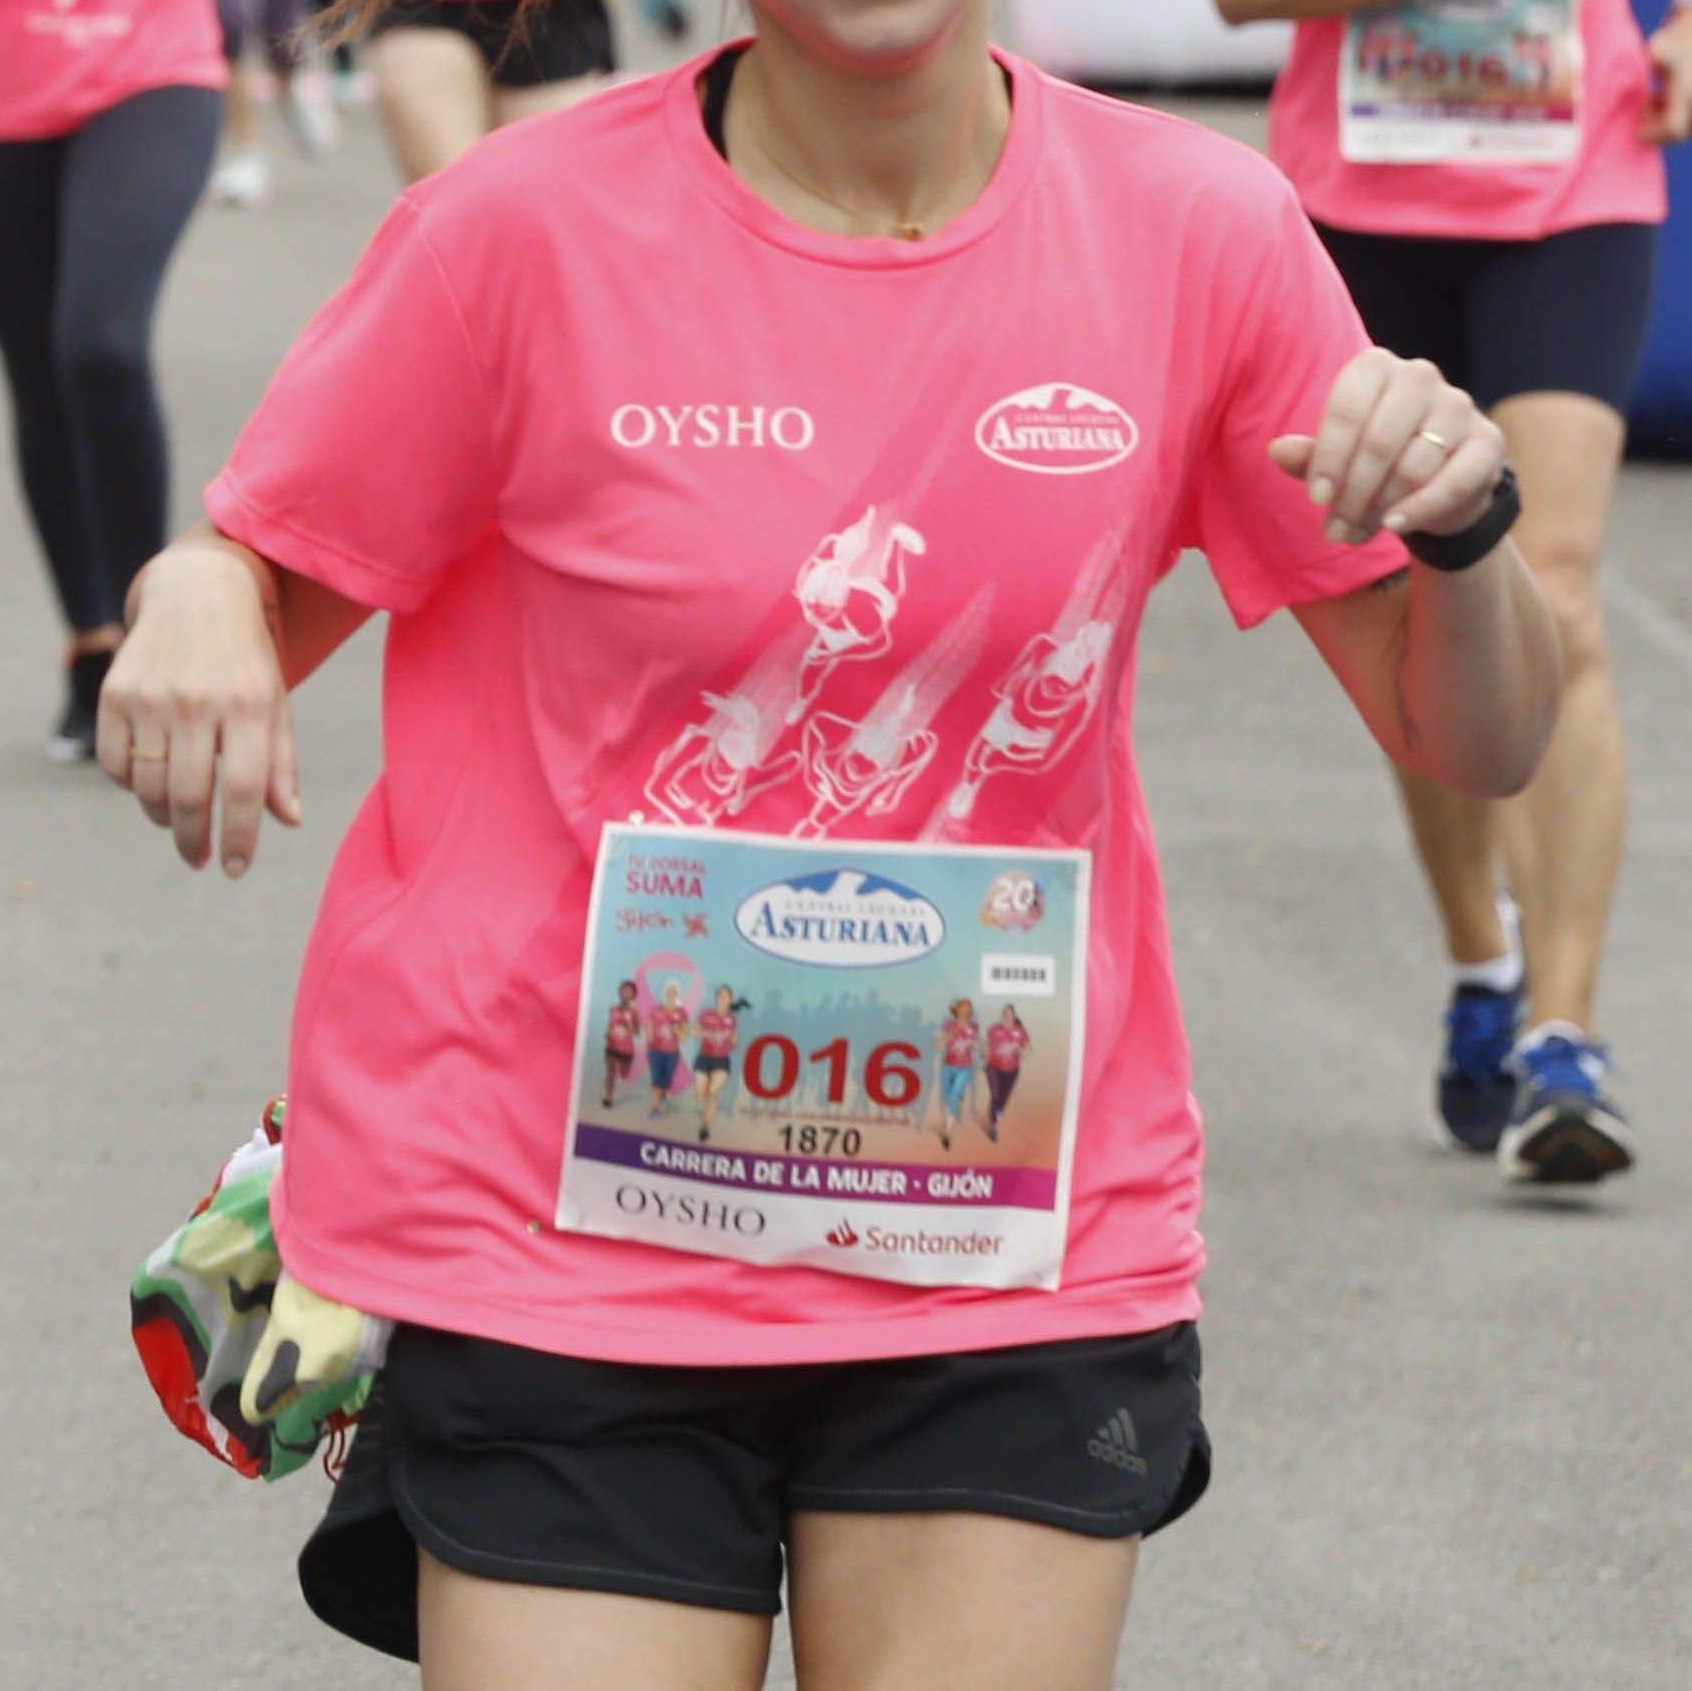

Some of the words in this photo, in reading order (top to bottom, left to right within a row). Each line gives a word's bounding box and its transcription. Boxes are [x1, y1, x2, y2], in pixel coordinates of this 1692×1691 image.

[610, 404, 814, 450] OYSHO
[991, 415, 1126, 450] ASTURIANA
[625, 869, 704, 900] SUMA
[995, 880, 1033, 910] 20
[750, 900, 931, 946] ASTURIANA
[743, 1033, 921, 1108] 016
[779, 1124, 861, 1156] 1870
[640, 1143, 746, 1179] CARRERA
[754, 1159, 783, 1185] DE
[790, 1162, 822, 1189] LA
[827, 1168, 906, 1196] MUJER
[928, 1169, 993, 1199] GIJÓN
[616, 1184, 766, 1237] OYSHO
[865, 1228, 1004, 1256] Santander
